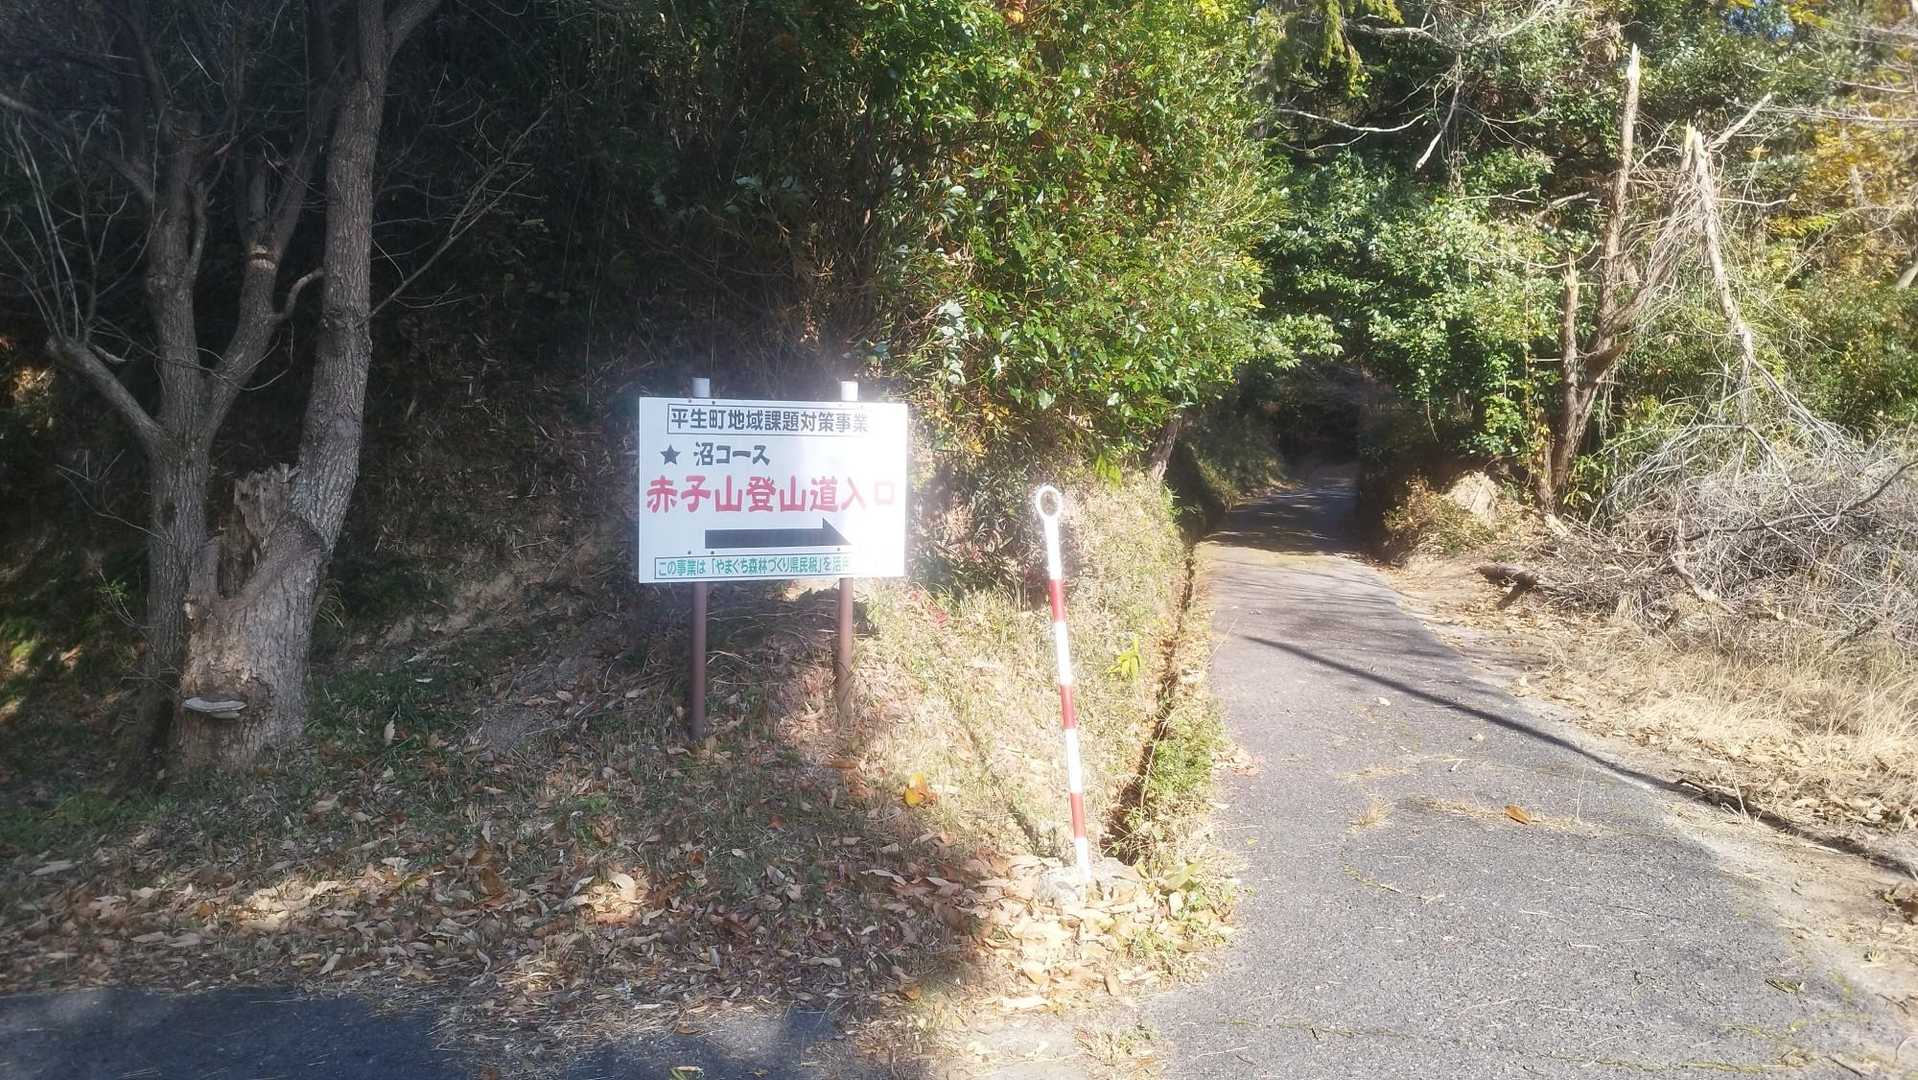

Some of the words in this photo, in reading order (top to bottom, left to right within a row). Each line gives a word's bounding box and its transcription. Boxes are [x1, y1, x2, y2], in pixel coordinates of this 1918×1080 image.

[671, 408, 869, 433] 平生町地域課題対策事業
[693, 441, 770, 466] 沼コース
[646, 475, 896, 513] 赤子山登山道入口
